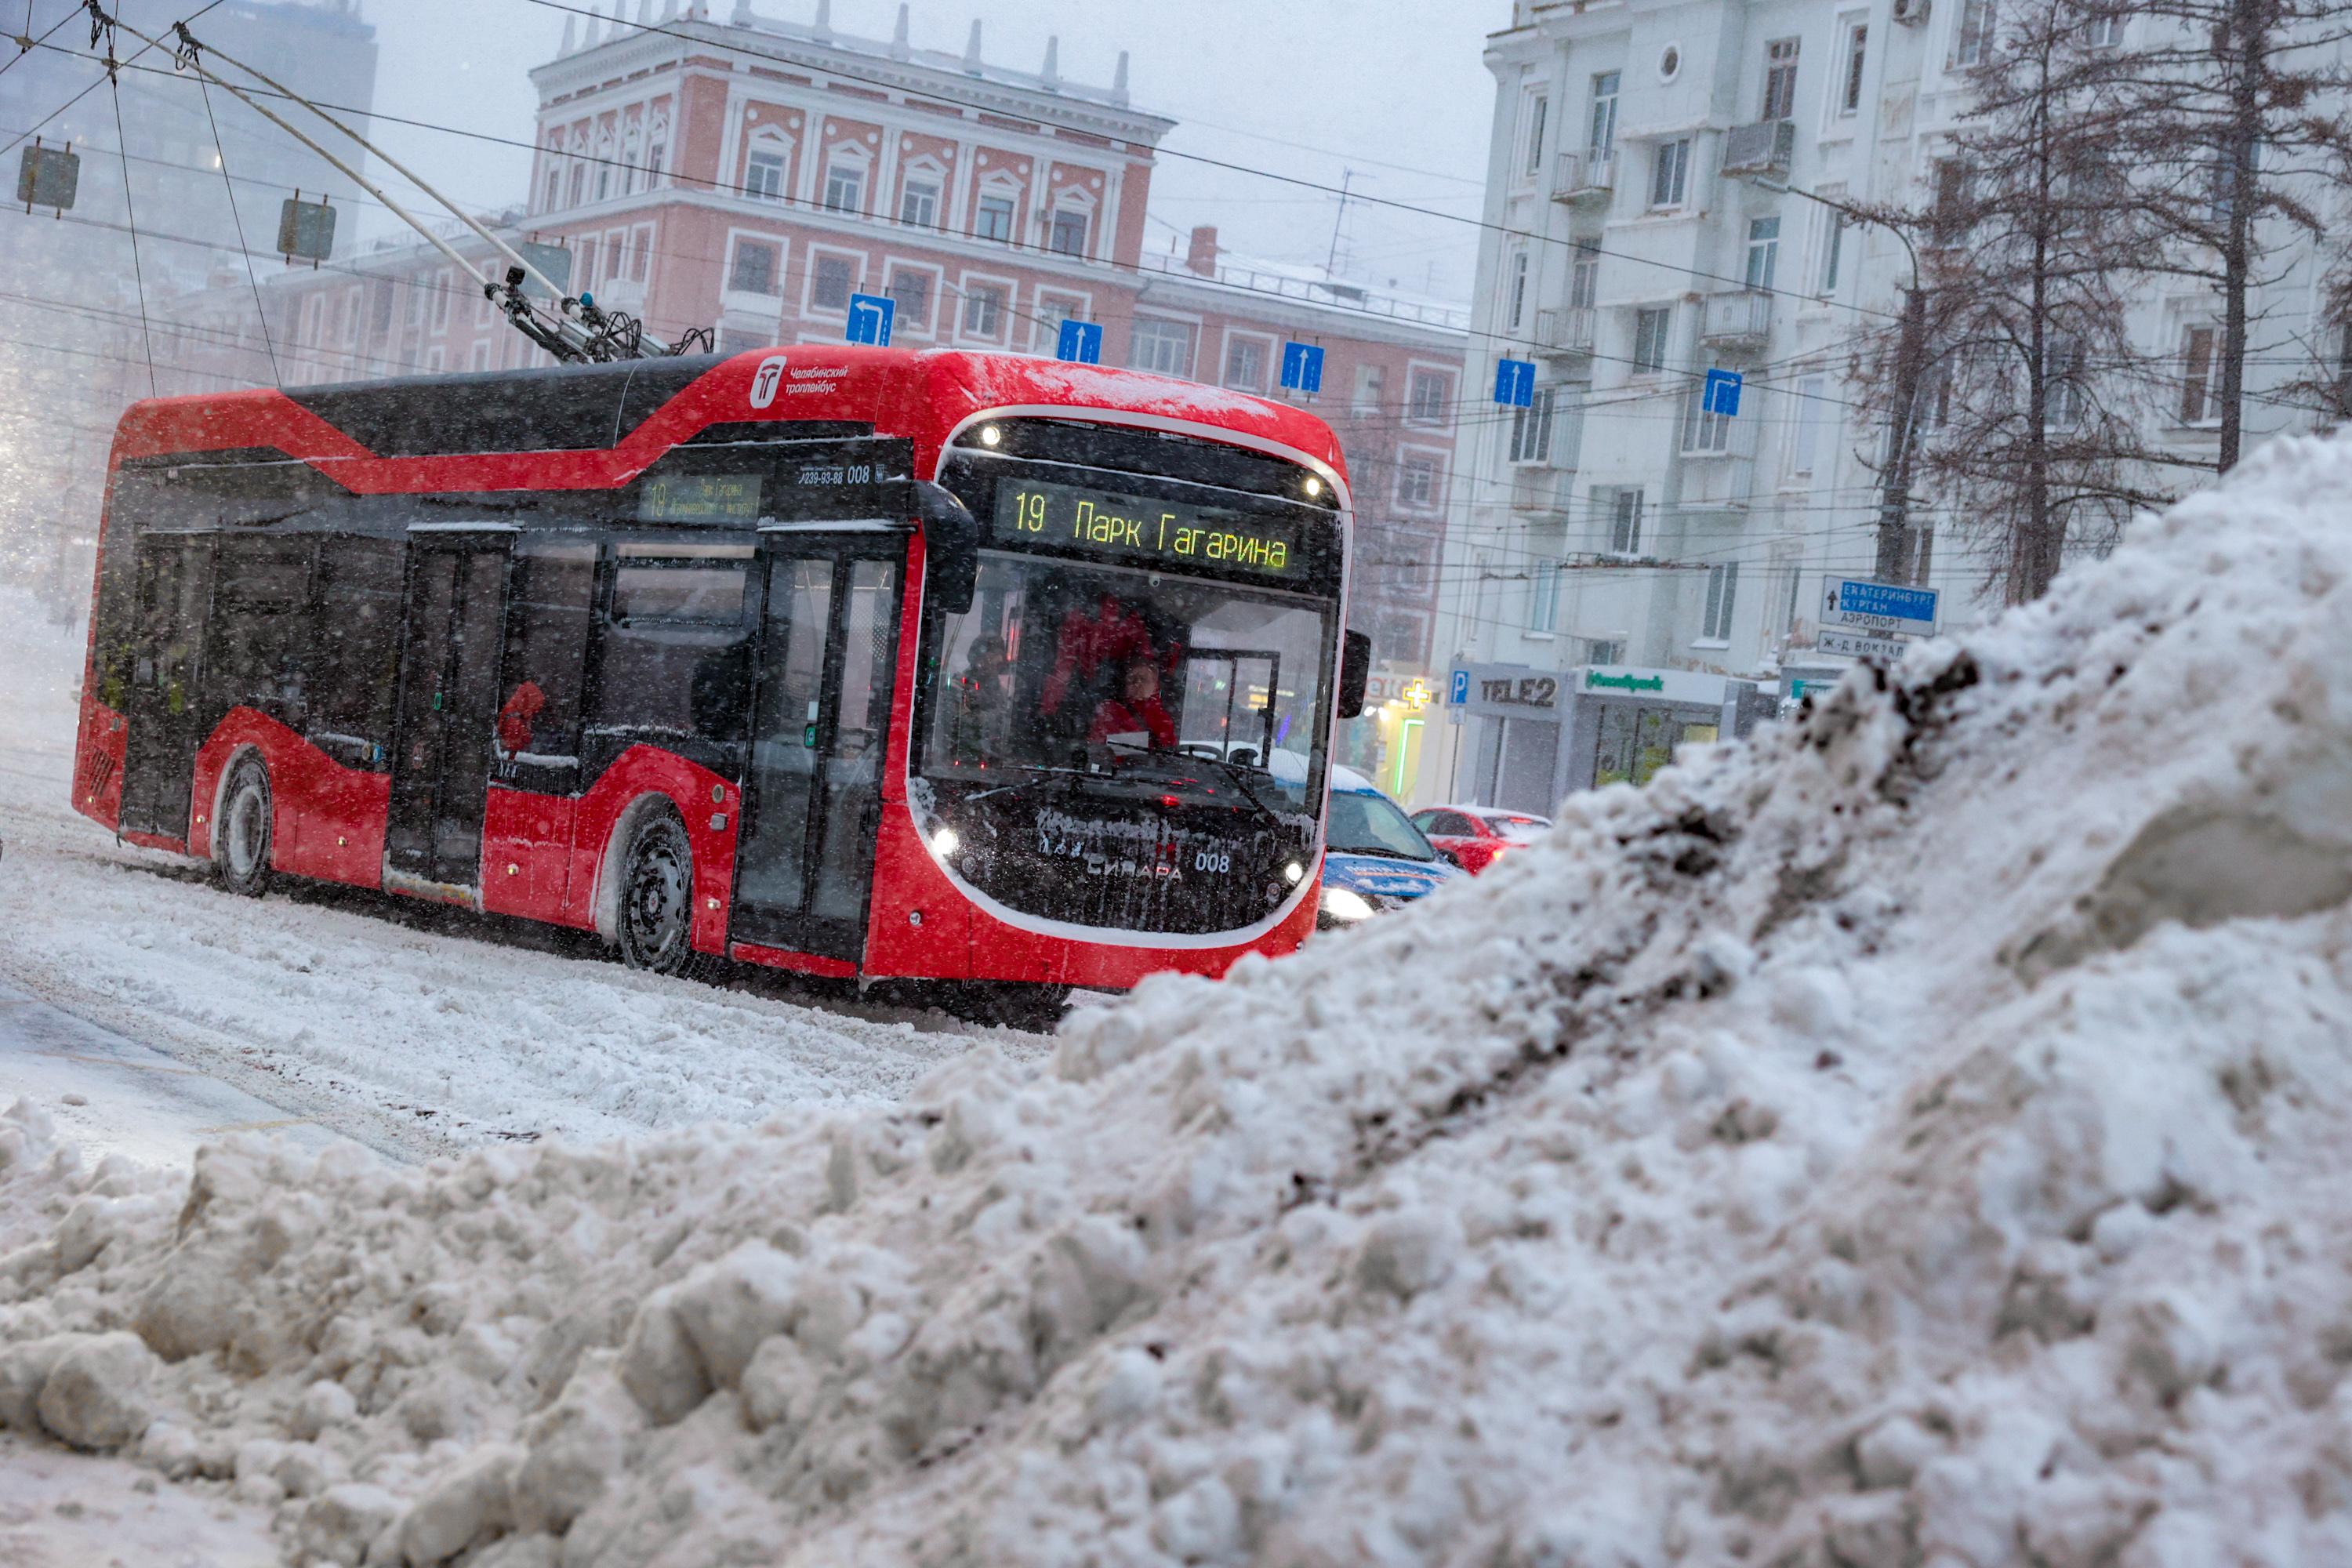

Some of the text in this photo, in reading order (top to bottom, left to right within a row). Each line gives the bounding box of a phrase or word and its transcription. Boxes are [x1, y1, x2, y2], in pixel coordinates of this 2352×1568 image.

[790, 365, 848, 379] Челябинский
[786, 380, 837, 396] троллейбус
[804, 471, 843, 485] 239-93-88
[848, 465, 870, 485] 008
[652, 483, 666, 517] 19
[1016, 492, 1287, 568] 19 Парк Гагарина
[1843, 585, 1933, 604] ЕКАТЕРИНБУРГ
[1842, 598, 1888, 612] КУРГАН
[1841, 612, 1903, 629] АЭРОПОРТ
[1481, 677, 1556, 707] TELE2
[1196, 852, 1229, 873] 008
